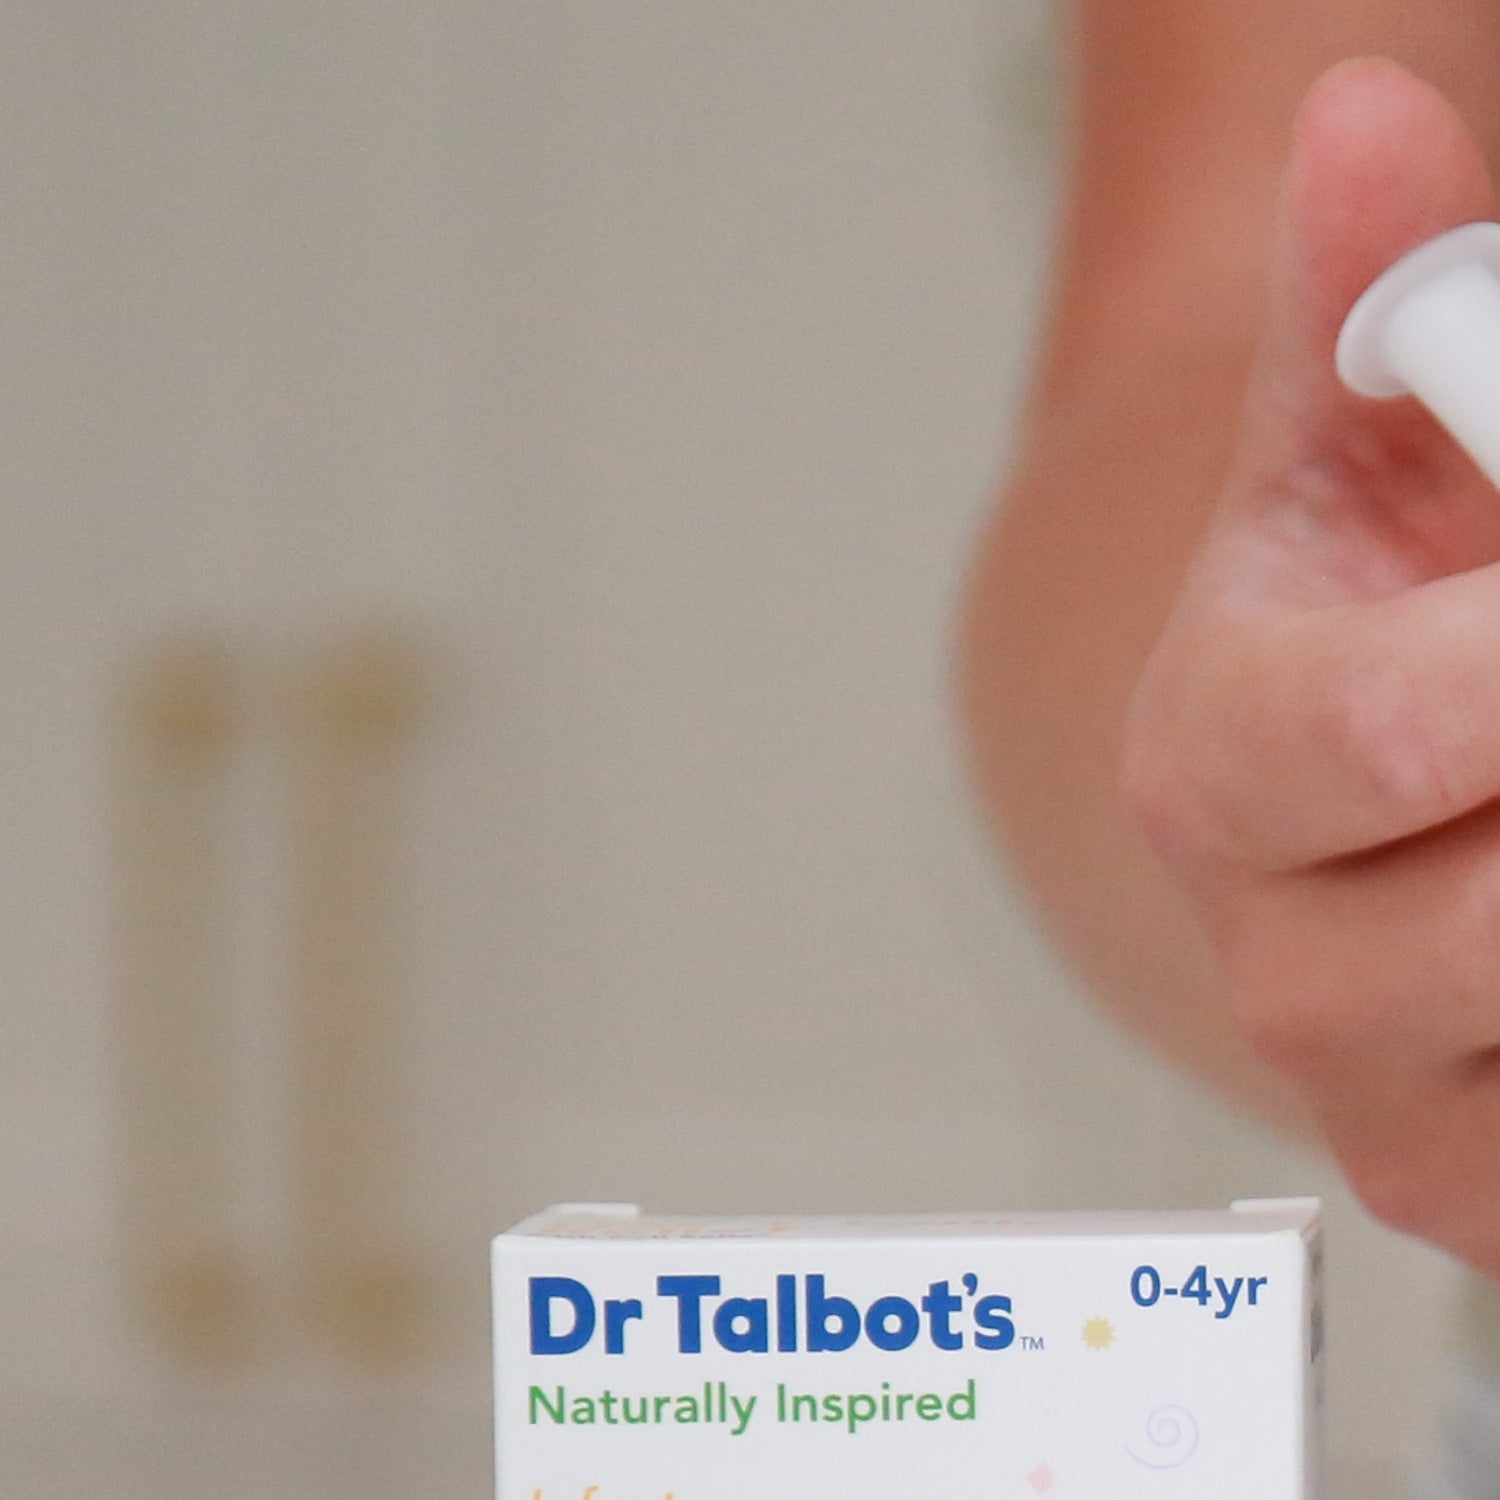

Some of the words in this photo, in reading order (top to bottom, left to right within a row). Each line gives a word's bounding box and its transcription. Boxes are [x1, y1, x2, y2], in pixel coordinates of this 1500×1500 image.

[528, 1276, 643, 1356] Dr
[1130, 1265, 1268, 1320] 0-4yr
[528, 1382, 757, 1436] Naturally
[776, 1378, 976, 1434] Inspired
